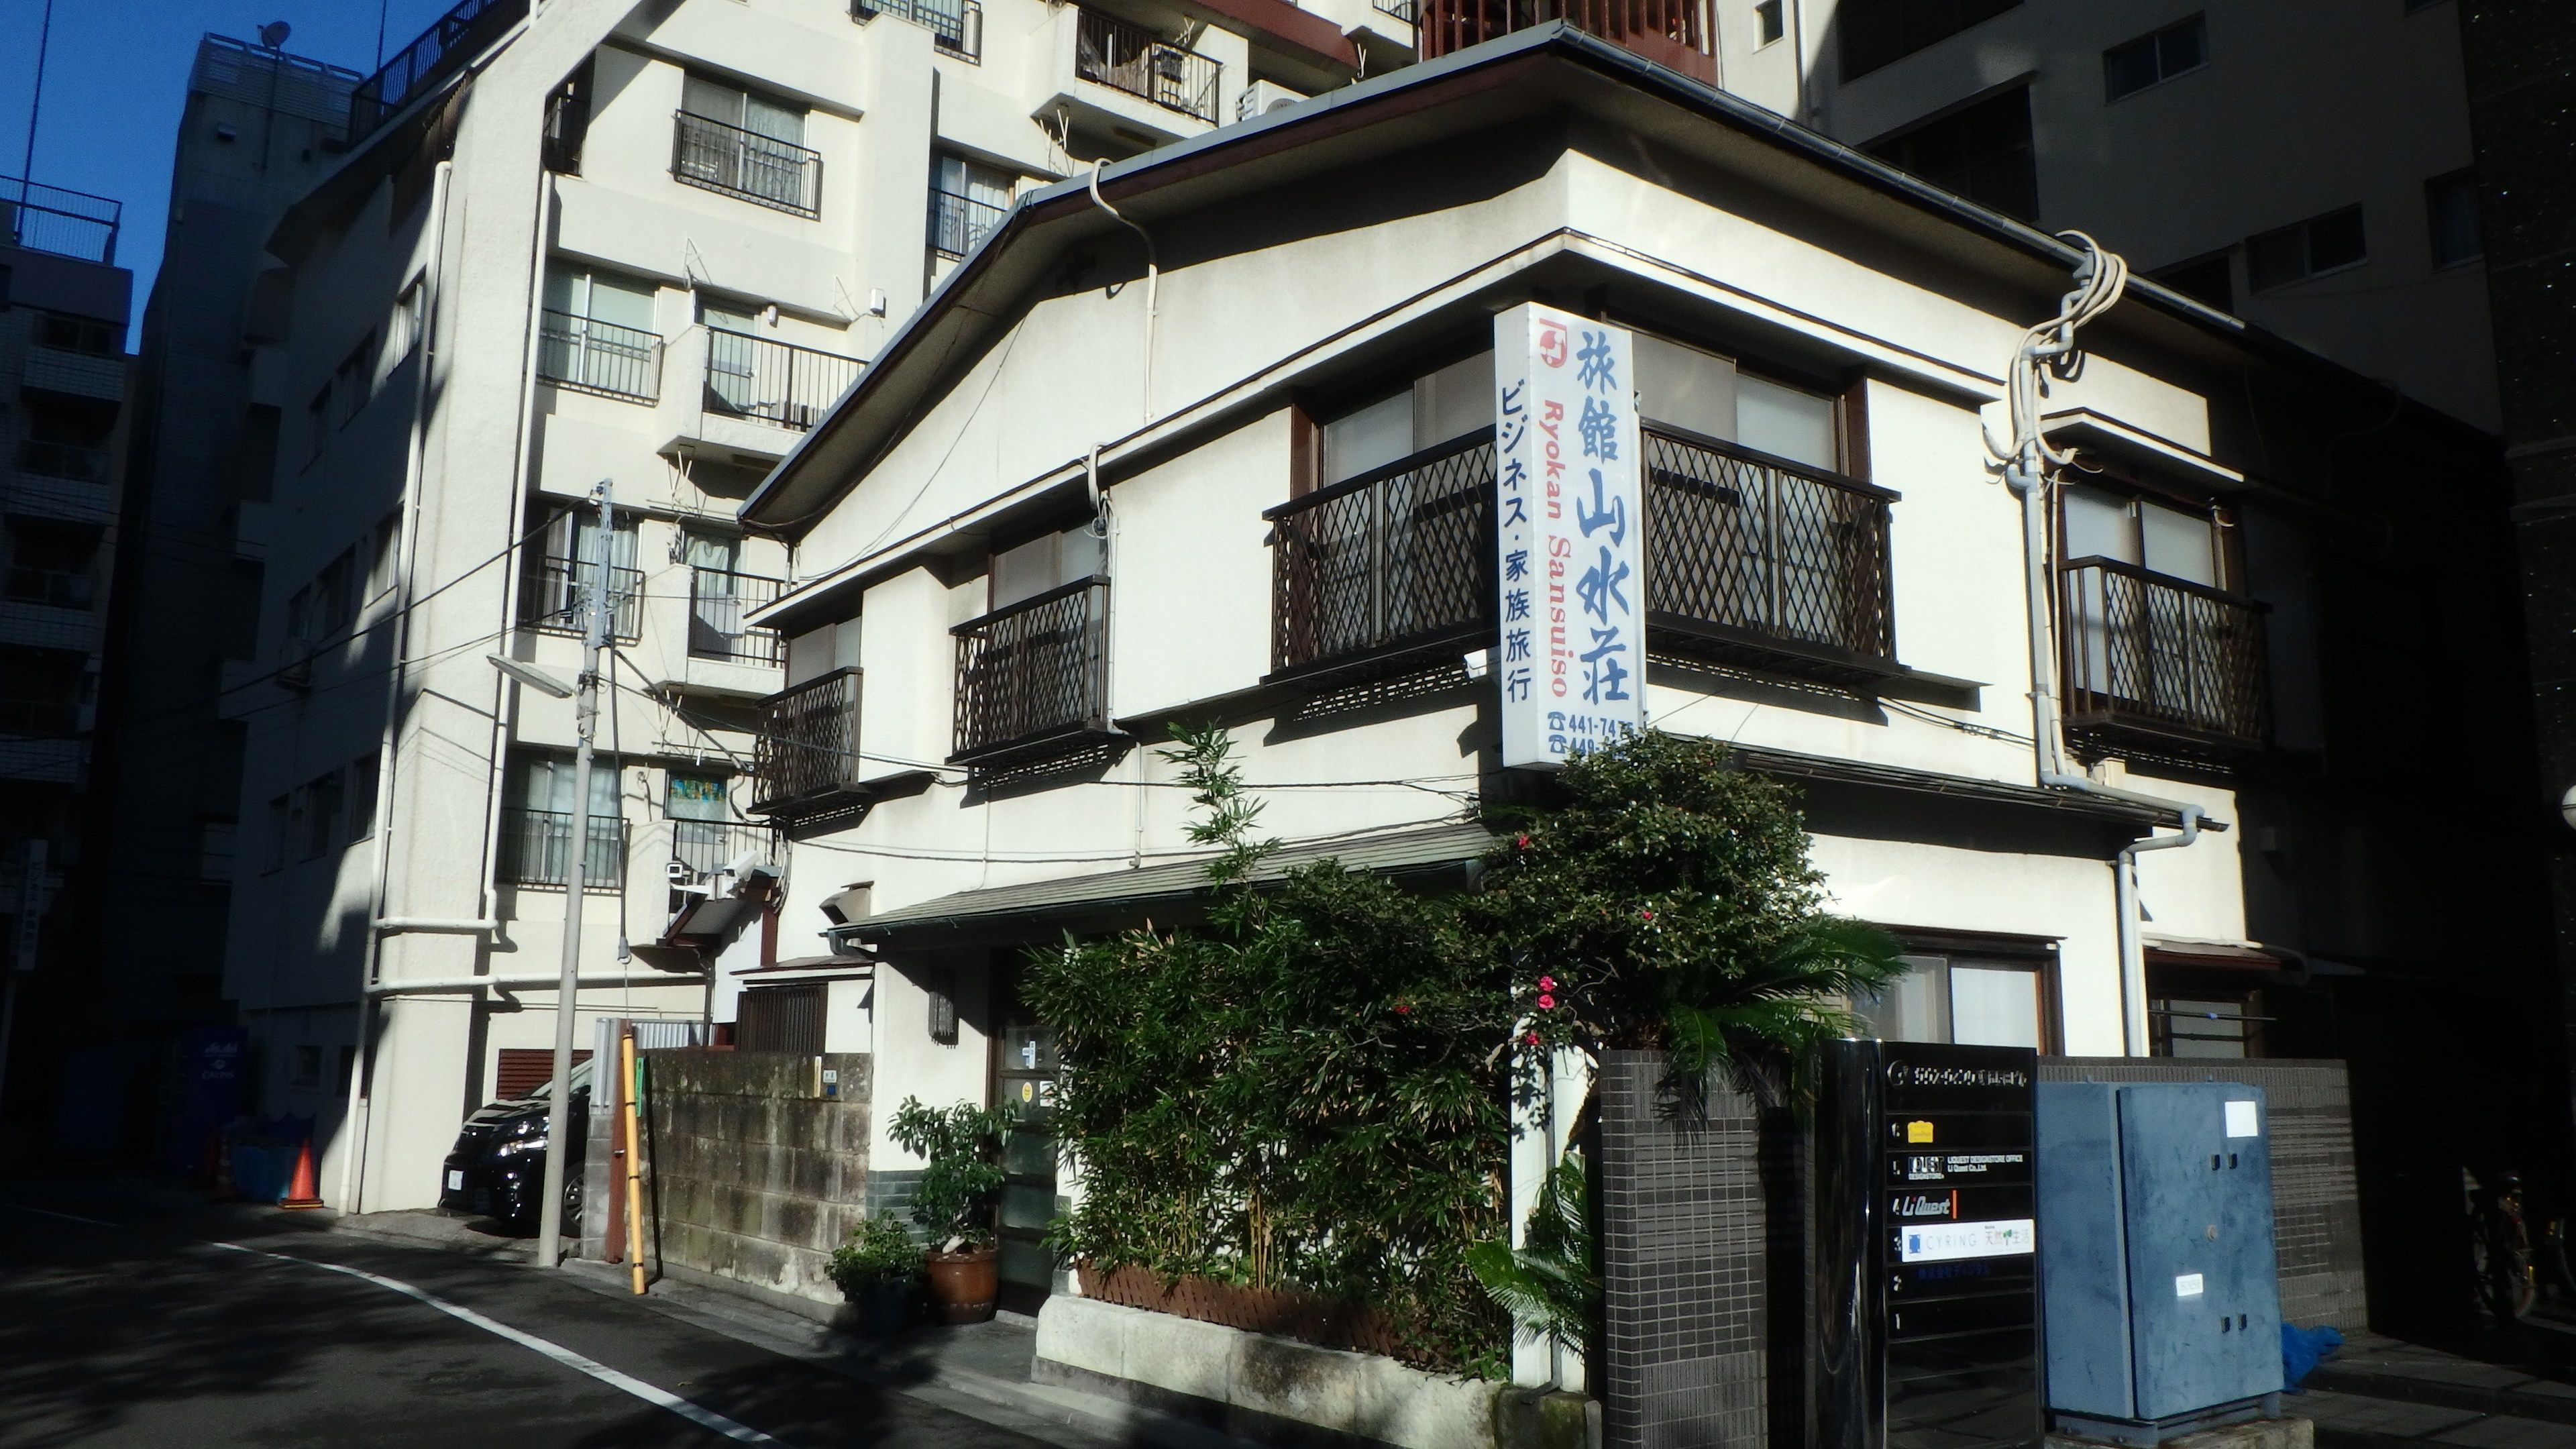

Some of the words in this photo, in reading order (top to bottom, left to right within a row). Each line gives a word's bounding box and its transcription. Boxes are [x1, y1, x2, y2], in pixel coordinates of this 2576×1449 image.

[1539, 400, 1566, 519] Ryokan
[1576, 331, 1630, 705] 旅館山水荘
[1548, 535, 1574, 698] Sansuiso
